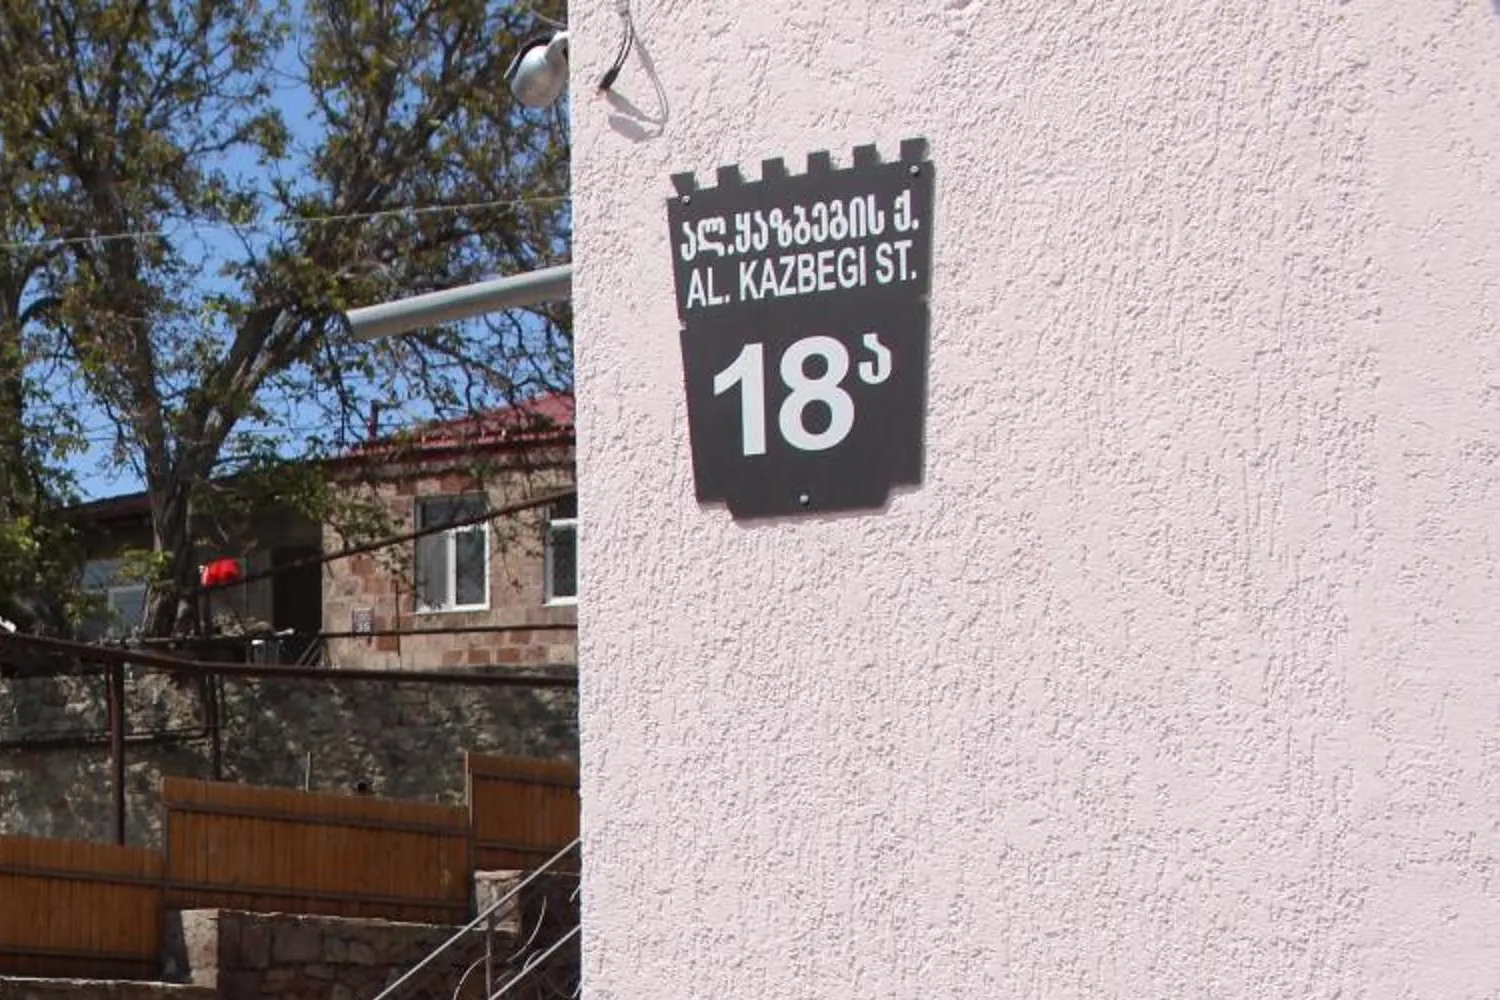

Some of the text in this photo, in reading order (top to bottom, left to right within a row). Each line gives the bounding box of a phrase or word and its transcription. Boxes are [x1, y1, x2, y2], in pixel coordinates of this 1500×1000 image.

[893, 189, 919, 232] ქ.
[687, 239, 917, 309] AL. KAZBEGI ST.
